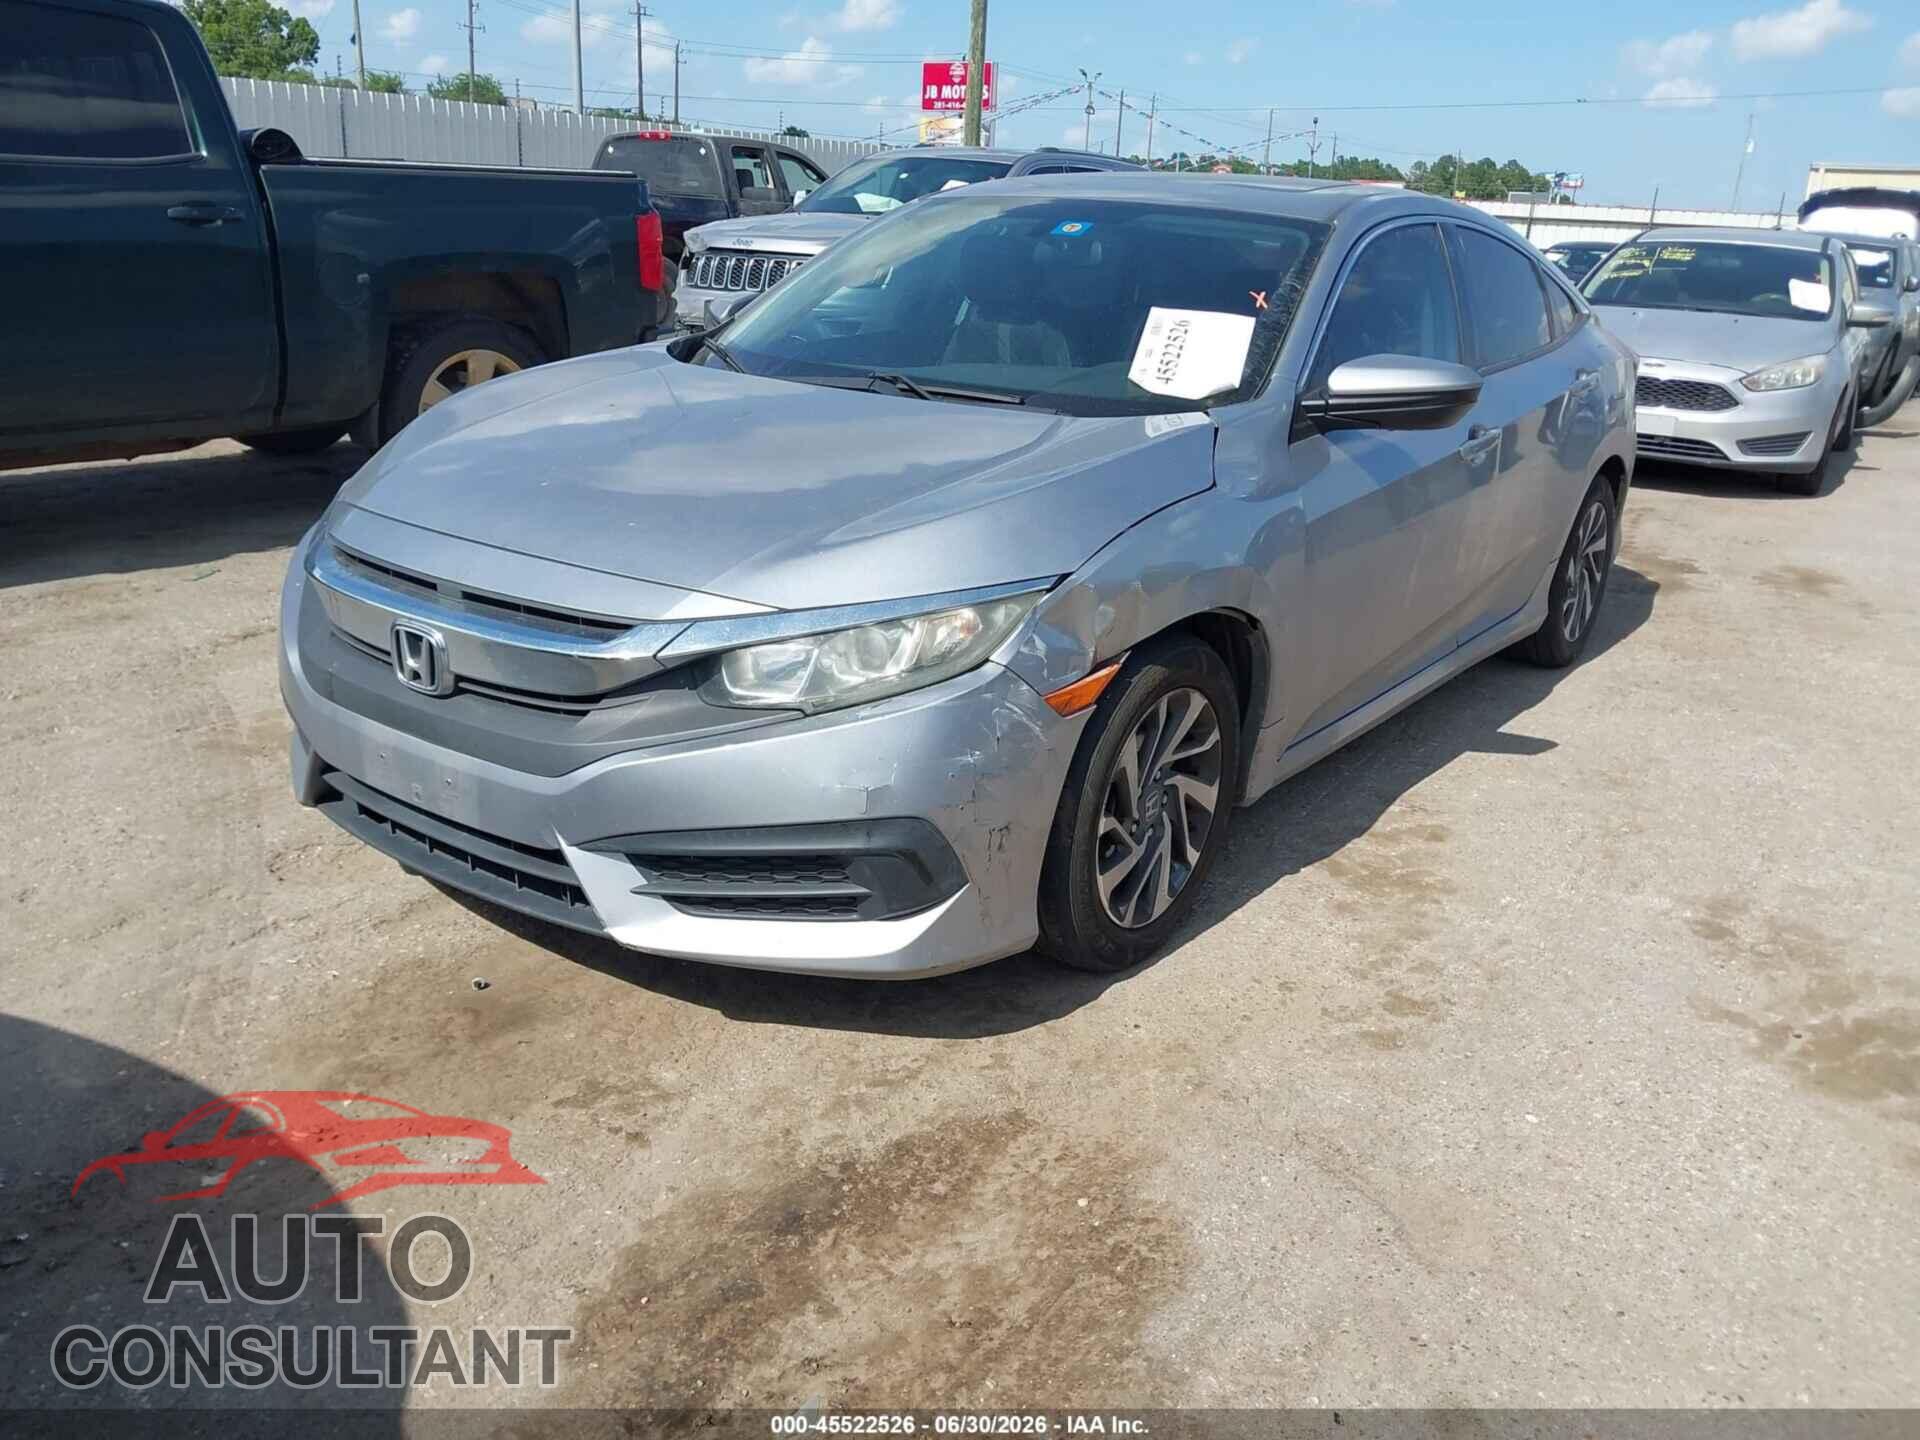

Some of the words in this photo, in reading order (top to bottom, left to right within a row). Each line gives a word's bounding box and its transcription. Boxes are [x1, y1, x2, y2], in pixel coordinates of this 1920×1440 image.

[925, 85, 938, 99] JB
[941, 85, 989, 99] MOTS
[1156, 320, 1191, 384] 45522526
